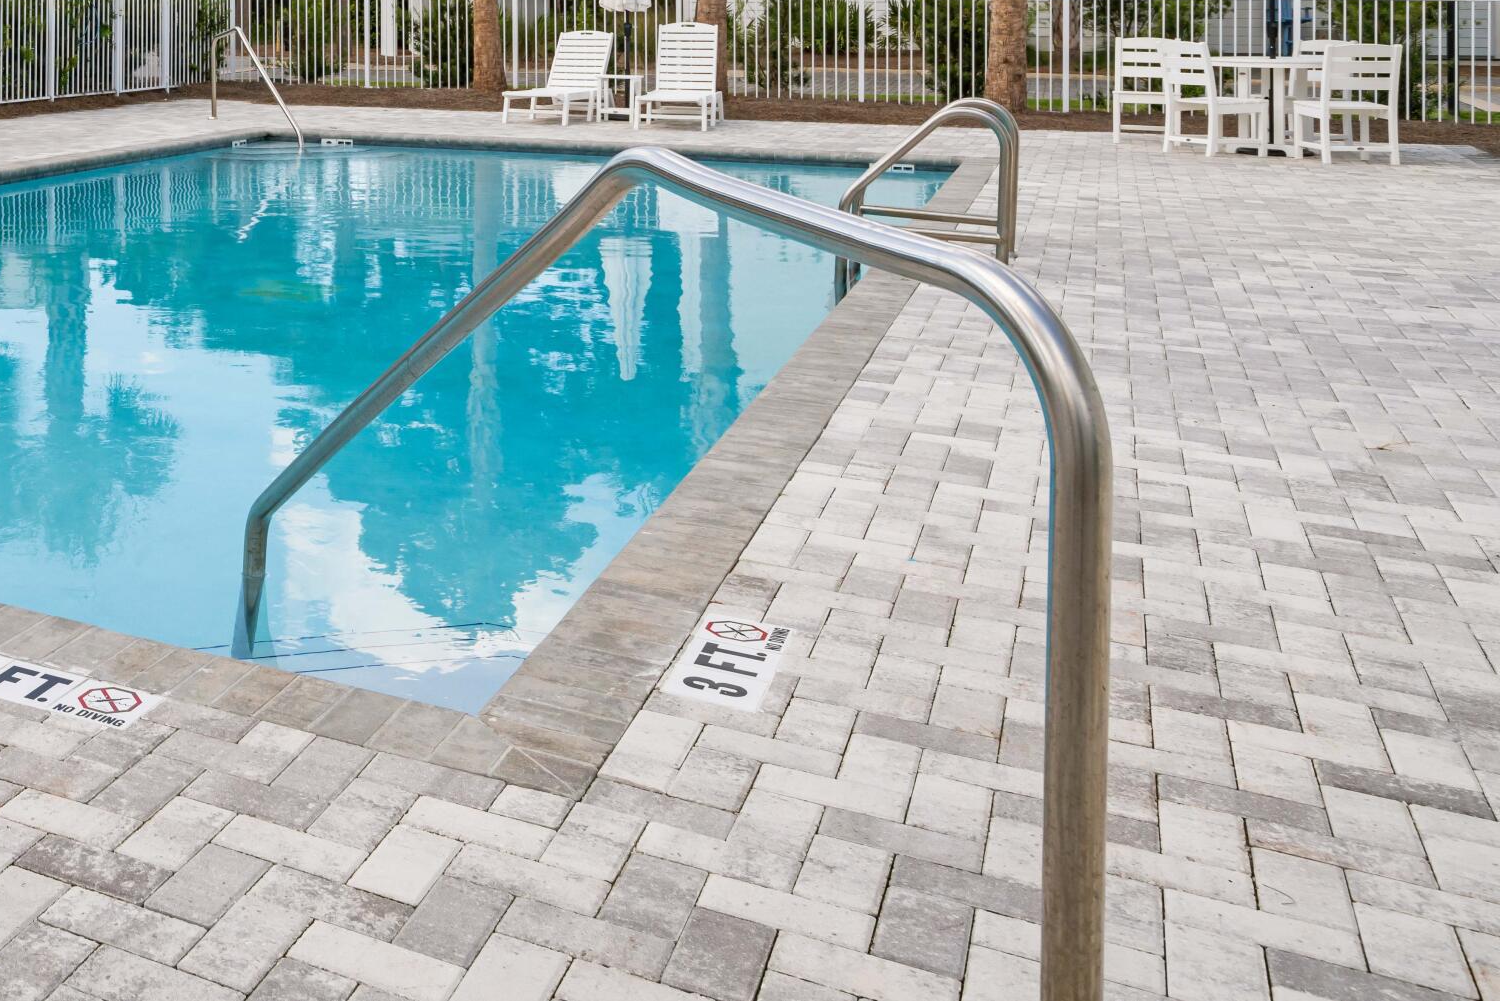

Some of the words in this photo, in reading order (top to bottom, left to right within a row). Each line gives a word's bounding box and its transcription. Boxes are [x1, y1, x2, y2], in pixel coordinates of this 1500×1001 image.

[693, 641, 768, 678] FT.
[683, 676, 748, 698] 3
[52, 703, 77, 717] NO
[76, 706, 126, 727] DIVING
